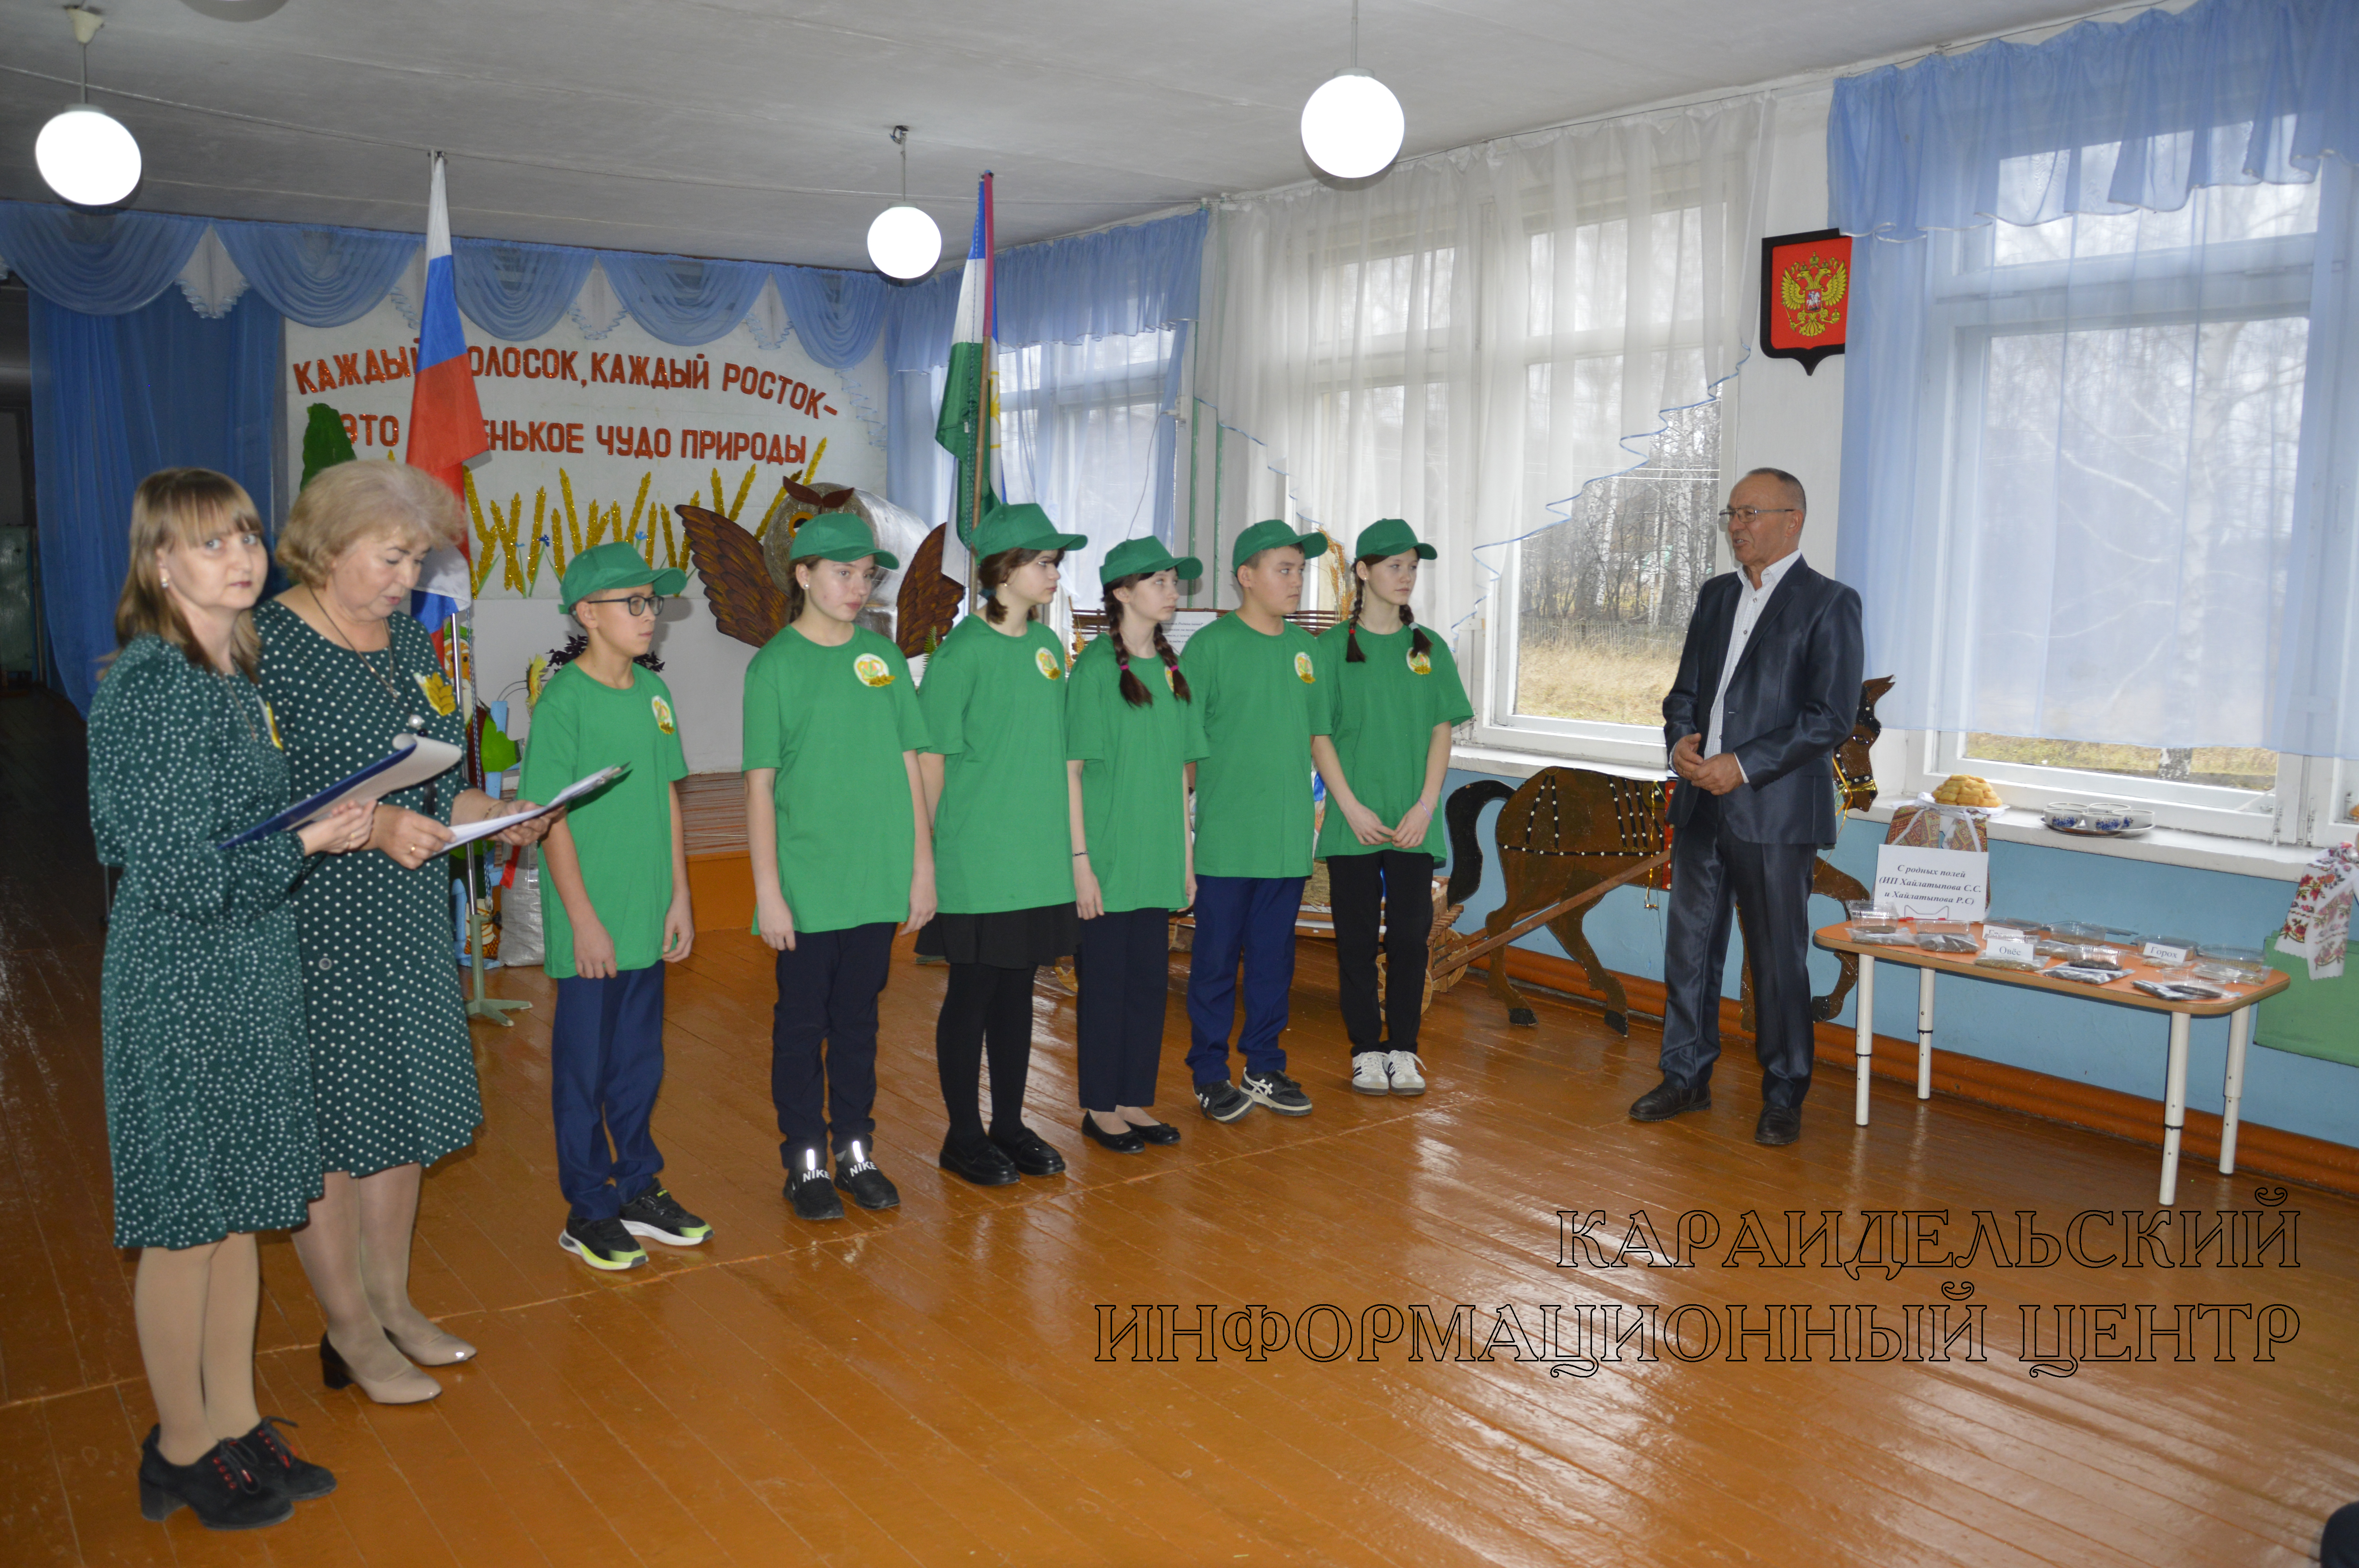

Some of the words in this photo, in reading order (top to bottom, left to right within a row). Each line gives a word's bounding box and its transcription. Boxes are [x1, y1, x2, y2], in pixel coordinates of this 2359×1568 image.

[467, 345, 587, 388] ОЛОСОК,
[591, 352, 709, 390] КАЖДЫЙ
[340, 413, 399, 447] ЭТО
[596, 425, 671, 460] ЧУДО
[681, 429, 807, 466] ПРИРОДЫ
[1905, 867, 1938, 875] родных
[1899, 878, 1961, 891] Хайлатыпова
[1964, 884, 1981, 893] С.С.
[1892, 891, 1954, 903] Хайлатыпова
[1956, 897, 1974, 905] Р.С)
[1999, 946, 2021, 956] Овёс
[2150, 947, 2178, 958] Горох
[803, 1169, 831, 1183] NIKE
[849, 1161, 878, 1177] NIKE
